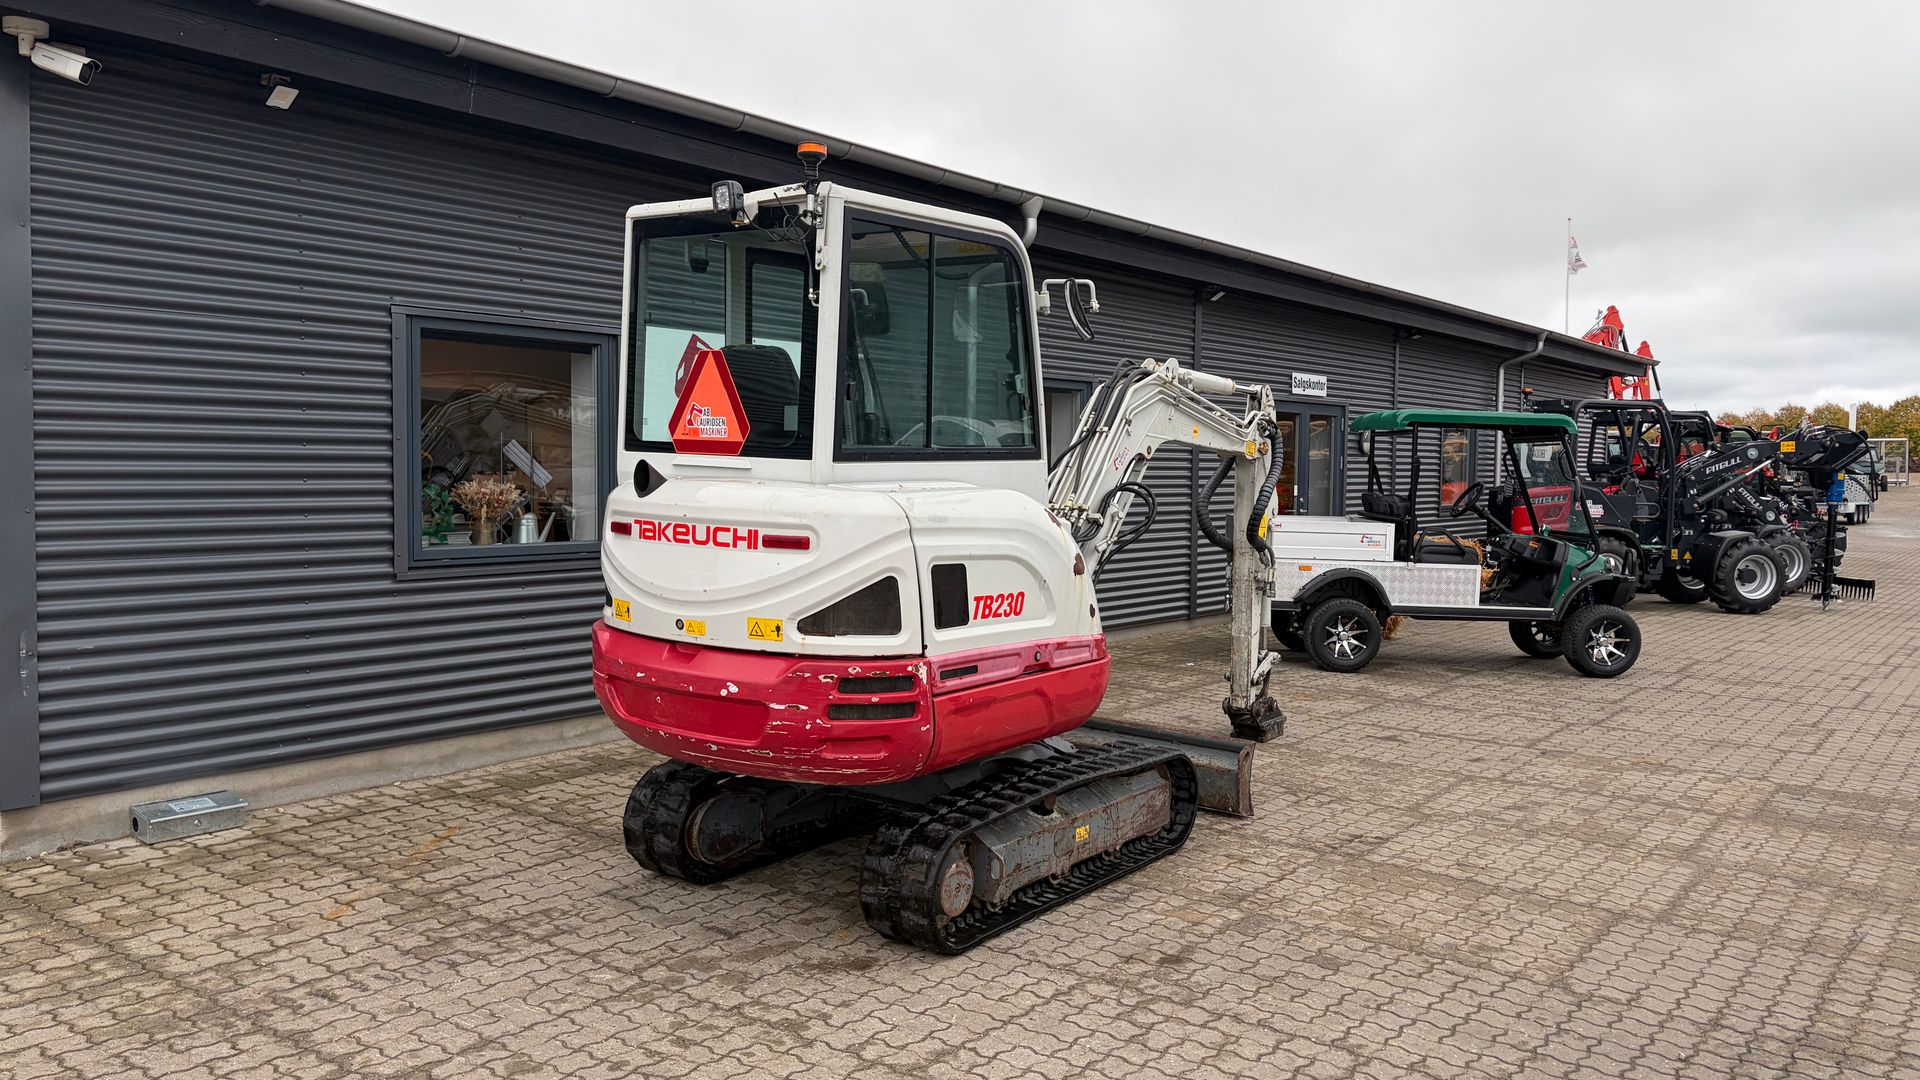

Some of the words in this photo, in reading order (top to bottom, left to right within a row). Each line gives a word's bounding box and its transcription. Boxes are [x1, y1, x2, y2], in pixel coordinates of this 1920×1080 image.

[1293, 376, 1326, 391] Salgskontor
[1706, 456, 1742, 475] PITBULL
[634, 519, 759, 550] TAKEUCHI
[973, 591, 1025, 620] TB230
